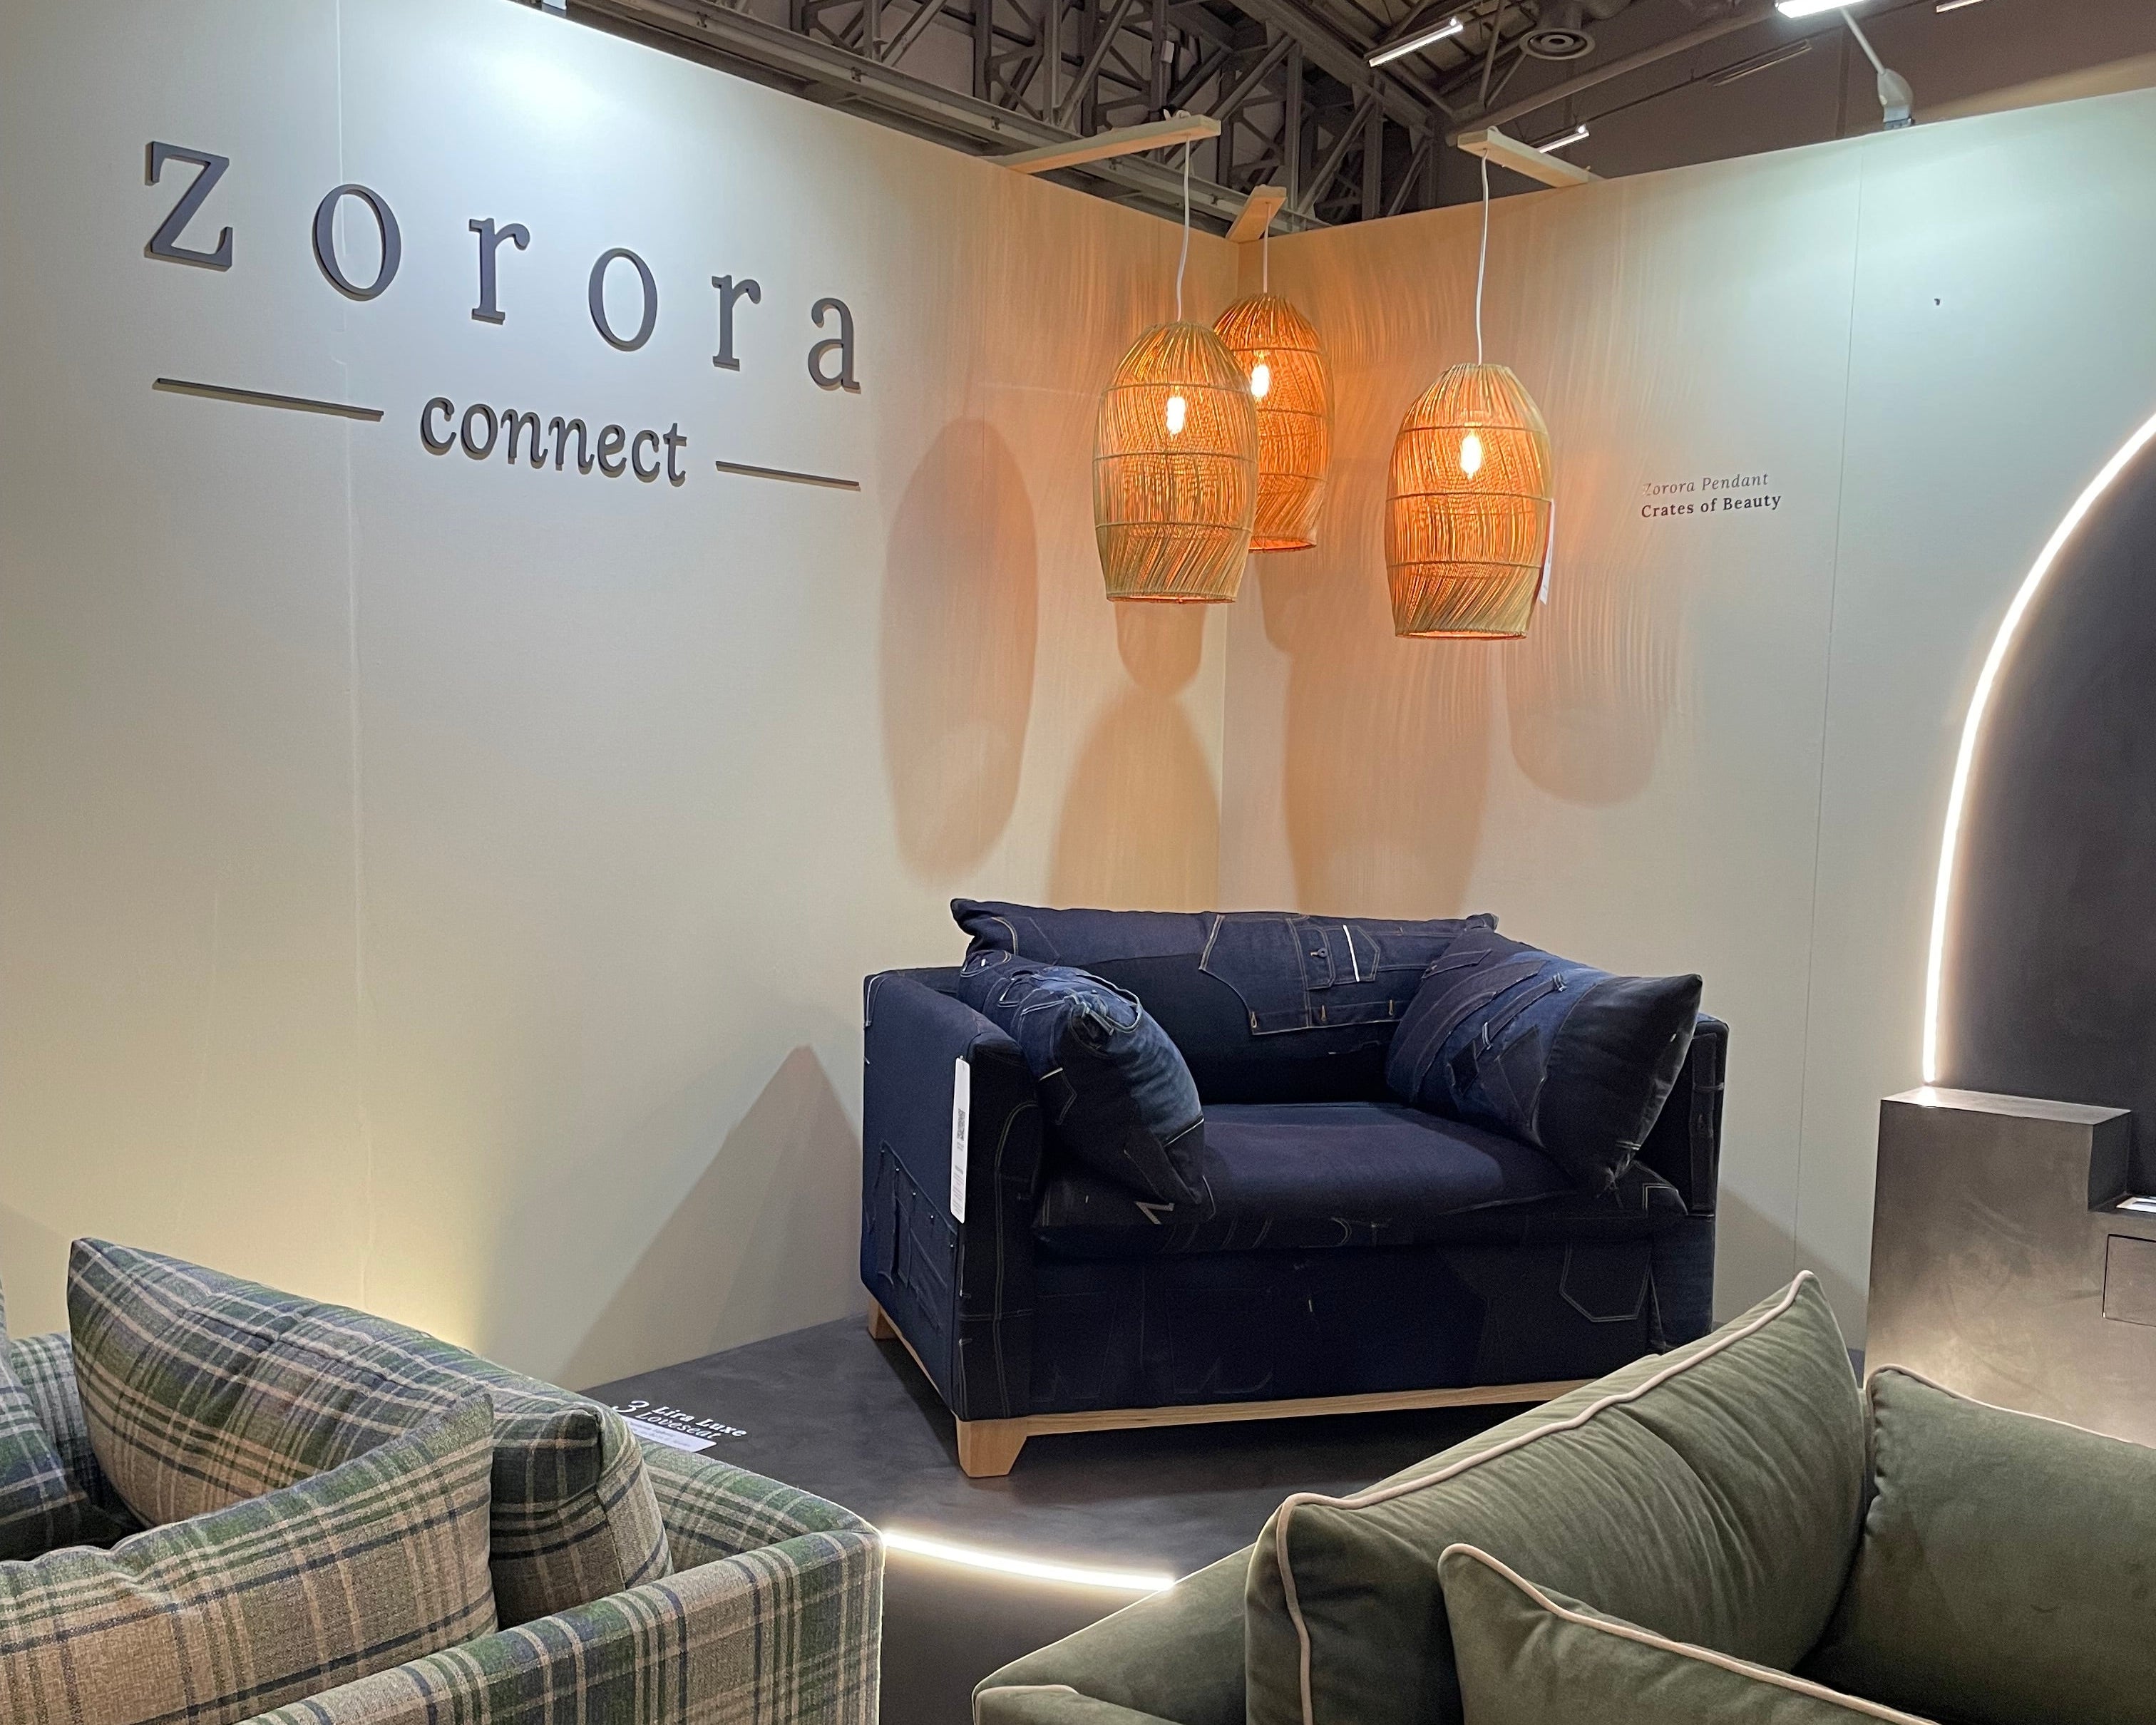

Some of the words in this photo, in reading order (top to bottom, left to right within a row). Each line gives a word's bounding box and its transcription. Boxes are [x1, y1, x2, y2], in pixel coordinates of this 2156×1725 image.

[145, 140, 861, 393] zorora
[421, 396, 687, 485] connect
[1702, 473, 1769, 491] Pendant
[1641, 503, 1695, 518] Crates
[1700, 498, 1718, 513] of
[1723, 495, 1782, 510] Beauty
[612, 1400, 650, 1413] 3
[651, 1406, 695, 1421] Lira
[695, 1418, 747, 1438] Luxe
[635, 1411, 722, 1439] Loveseat
